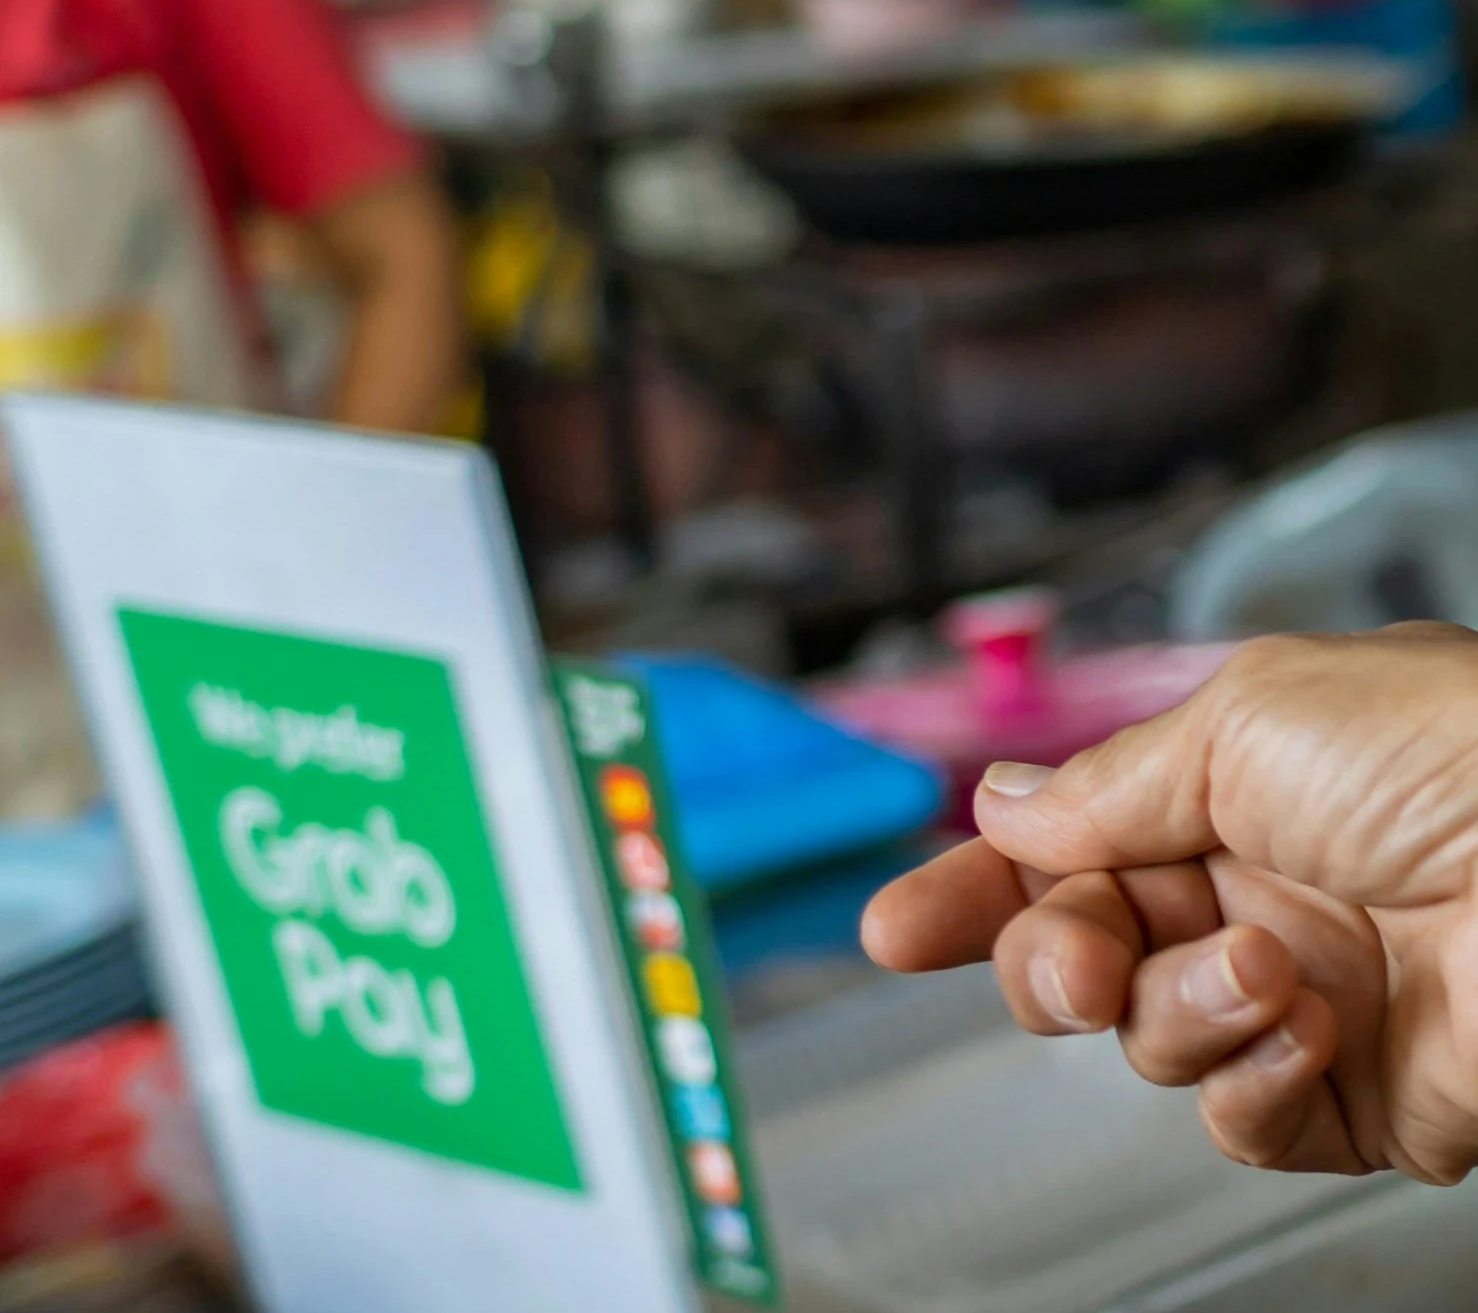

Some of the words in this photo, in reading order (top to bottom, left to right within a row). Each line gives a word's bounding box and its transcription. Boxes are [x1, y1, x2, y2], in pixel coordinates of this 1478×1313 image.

[188, 683, 272, 757] We
[269, 705, 406, 782] prefer
[218, 786, 457, 948] Grab
[272, 917, 475, 1106] Pay
